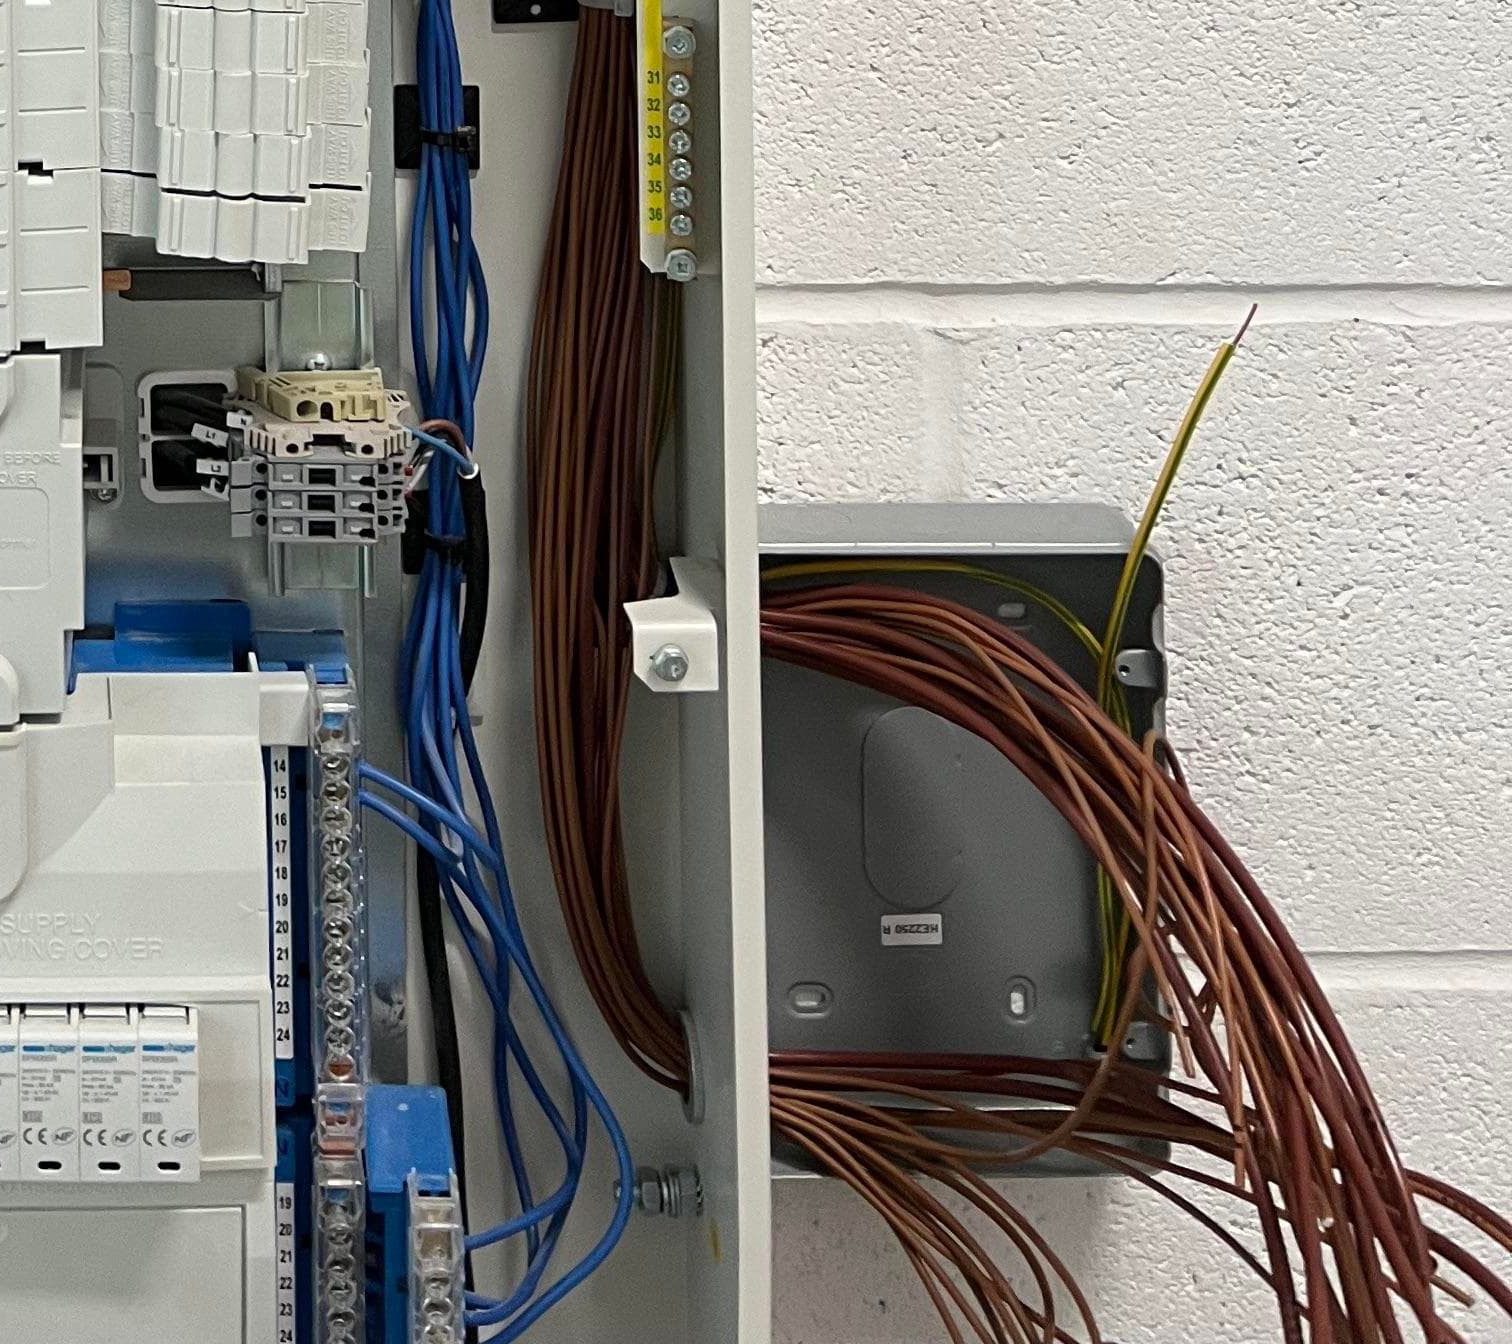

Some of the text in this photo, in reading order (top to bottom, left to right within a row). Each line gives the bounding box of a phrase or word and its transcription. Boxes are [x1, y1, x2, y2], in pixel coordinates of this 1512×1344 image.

[647, 71, 660, 83] 31
[647, 99, 660, 111] 32
[648, 126, 661, 138] 33
[648, 153, 661, 165] 34
[648, 181, 662, 192] 35
[649, 208, 662, 220] 36
[274, 760, 286, 772] 14
[274, 787, 287, 799] 15
[275, 813, 287, 825] 16
[275, 840, 287, 852] 17
[275, 867, 288, 879] 18
[276, 894, 288, 906] 19
[0, 913, 100, 934] SUPPLY
[276, 921, 288, 933] 20
[74, 938, 163, 959] COVER
[276, 947, 288, 960] 21
[276, 975, 289, 987] 22
[277, 1002, 290, 1014] 23
[277, 1028, 290, 1041] 24
[279, 1197, 291, 1209] 19
[279, 1223, 292, 1236] 20
[280, 1250, 292, 1262] 21
[280, 1277, 292, 1289] 22
[280, 1303, 292, 1315] 23
[280, 1330, 292, 1342] 24
